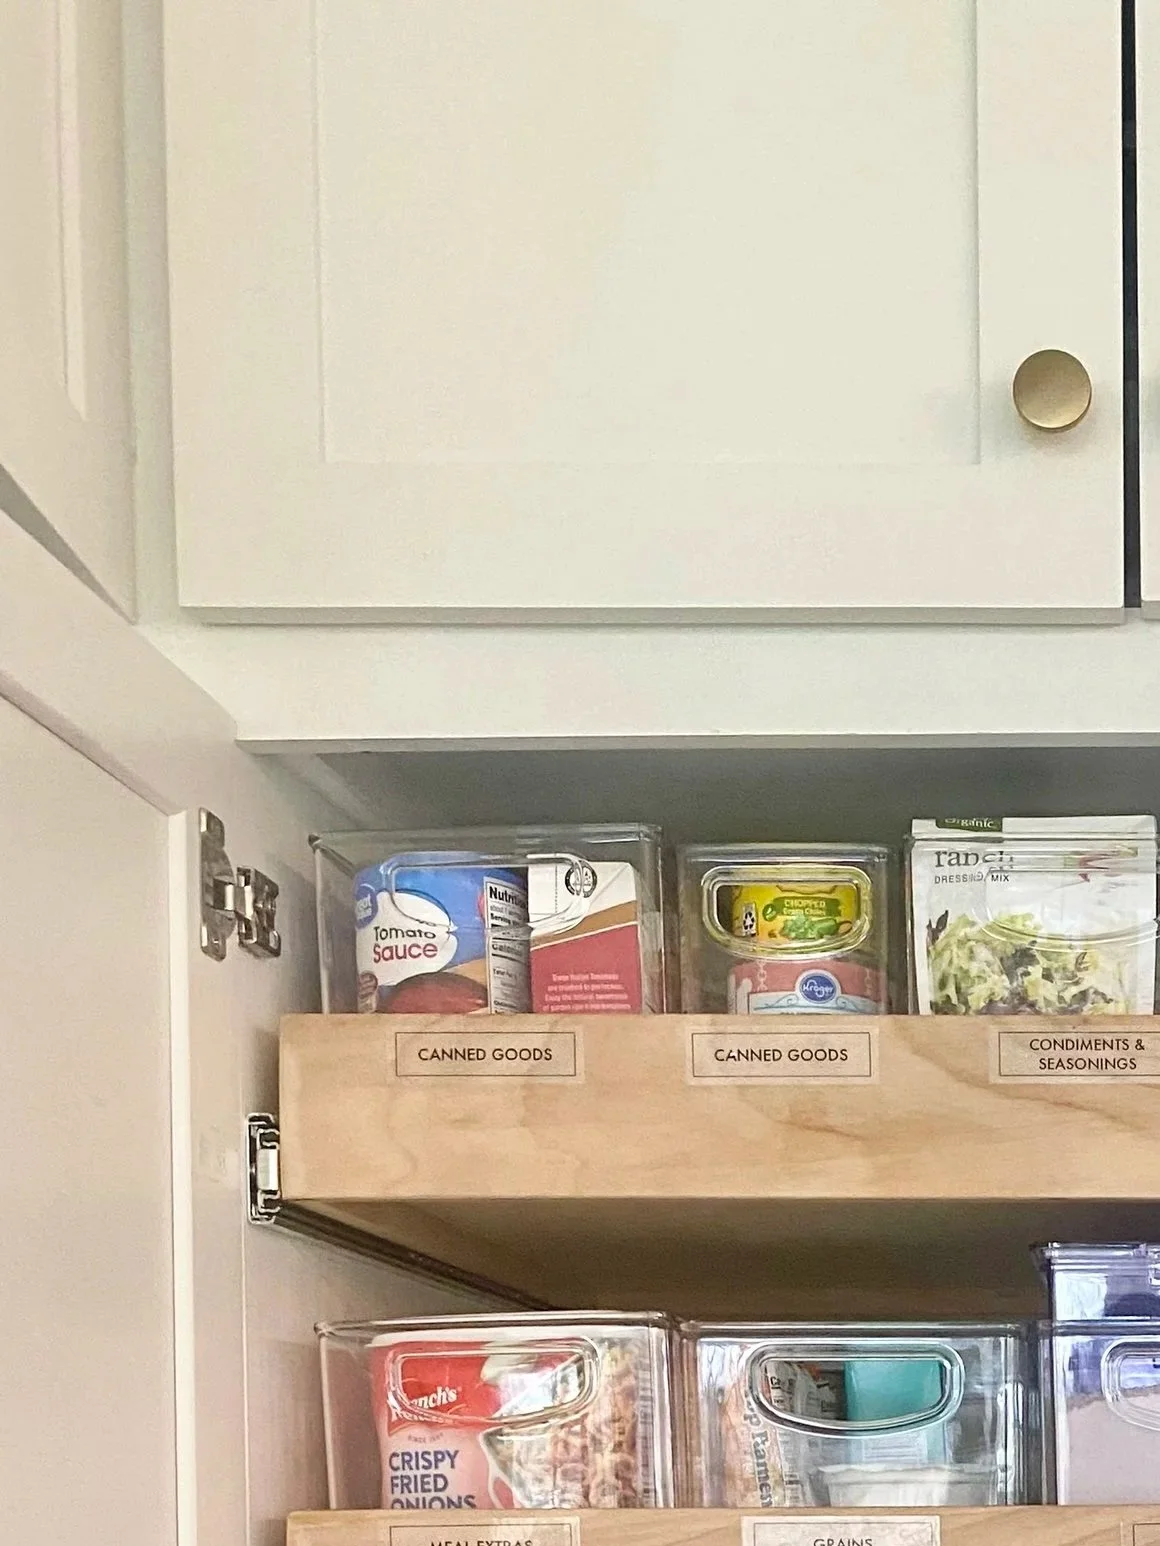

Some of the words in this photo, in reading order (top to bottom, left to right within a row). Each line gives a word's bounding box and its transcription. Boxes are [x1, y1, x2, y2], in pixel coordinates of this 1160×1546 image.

[945, 817, 994, 828] Organic
[934, 850, 1014, 869] ranch
[991, 874, 1010, 883] MIX
[784, 899, 826, 908] CHOPPED
[373, 926, 436, 941] Tomato
[373, 943, 438, 964] Sauce
[802, 979, 834, 999] Kroger
[1029, 1038, 1129, 1051] CONDIMENTS
[1135, 1038, 1145, 1051] &
[417, 1047, 486, 1062] CANNED
[491, 1047, 553, 1061] GOODS
[714, 1048, 783, 1062] CANNED
[787, 1047, 848, 1062] GOODS
[1038, 1058, 1137, 1070] SEASONINGS
[389, 1450, 459, 1471] CRISPY
[391, 1473, 448, 1494] FRIED
